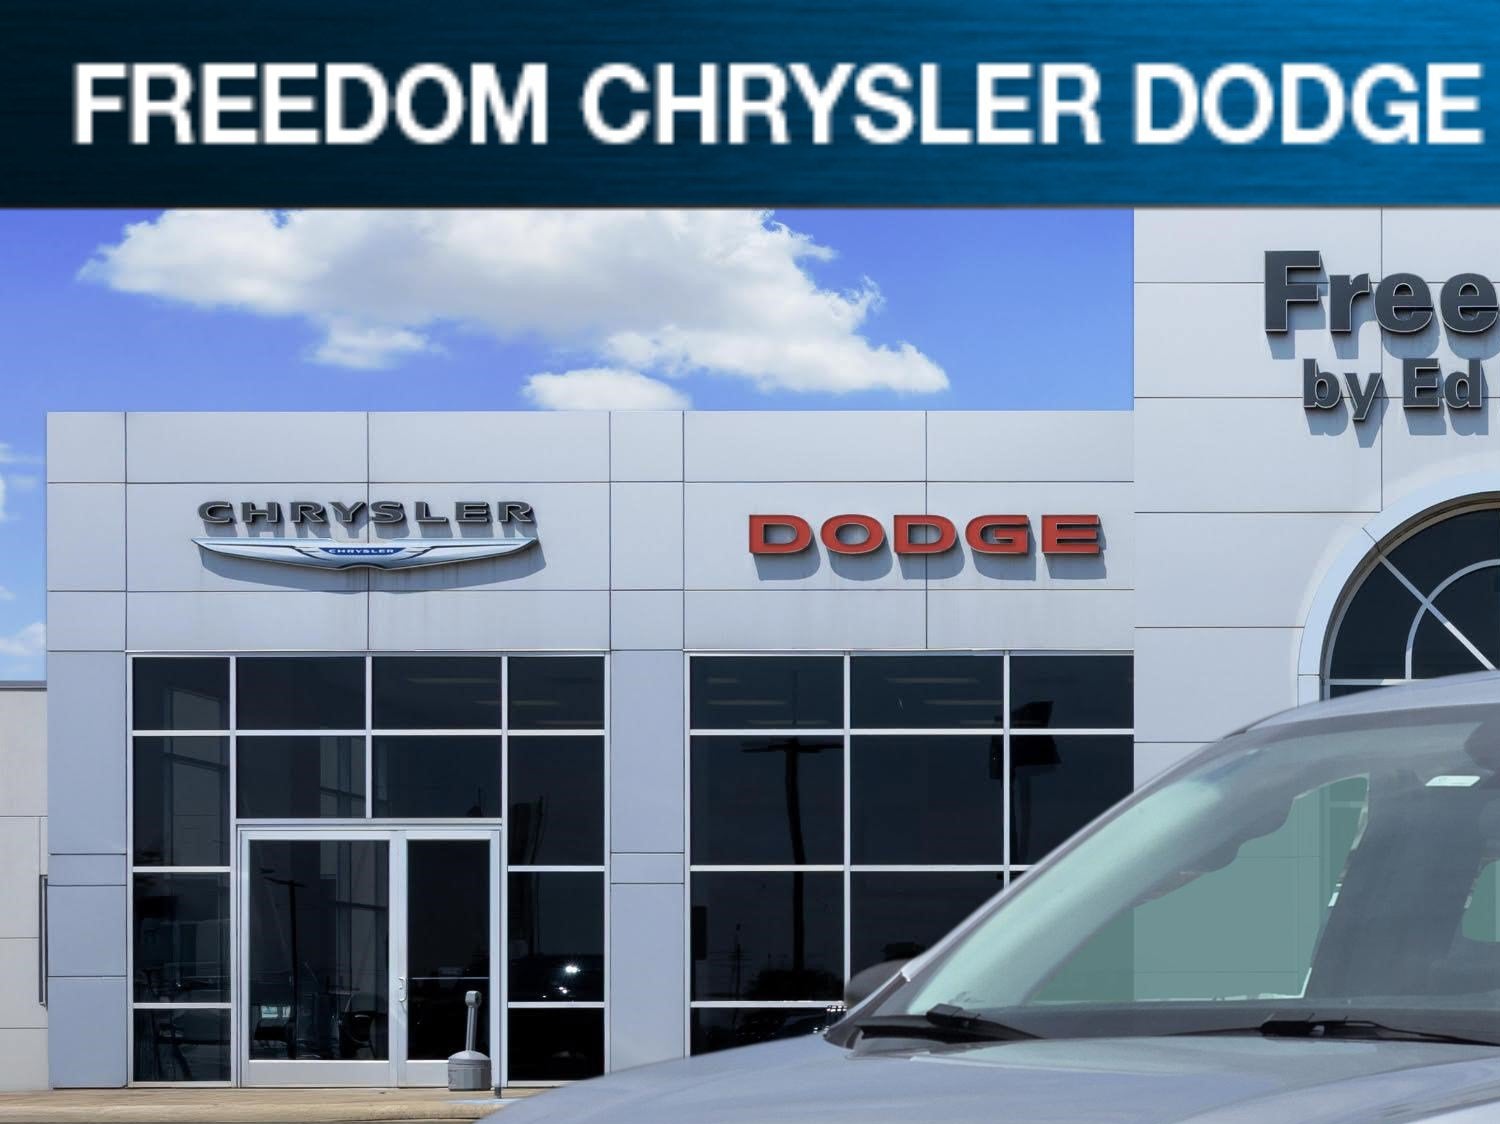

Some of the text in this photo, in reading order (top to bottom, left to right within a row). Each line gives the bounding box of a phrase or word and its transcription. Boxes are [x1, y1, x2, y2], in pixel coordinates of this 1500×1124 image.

[1303, 358, 1382, 421] by
[1402, 358, 1483, 408] Ed
[197, 500, 534, 523] CHRYSLER
[749, 514, 1100, 554] DODGE
